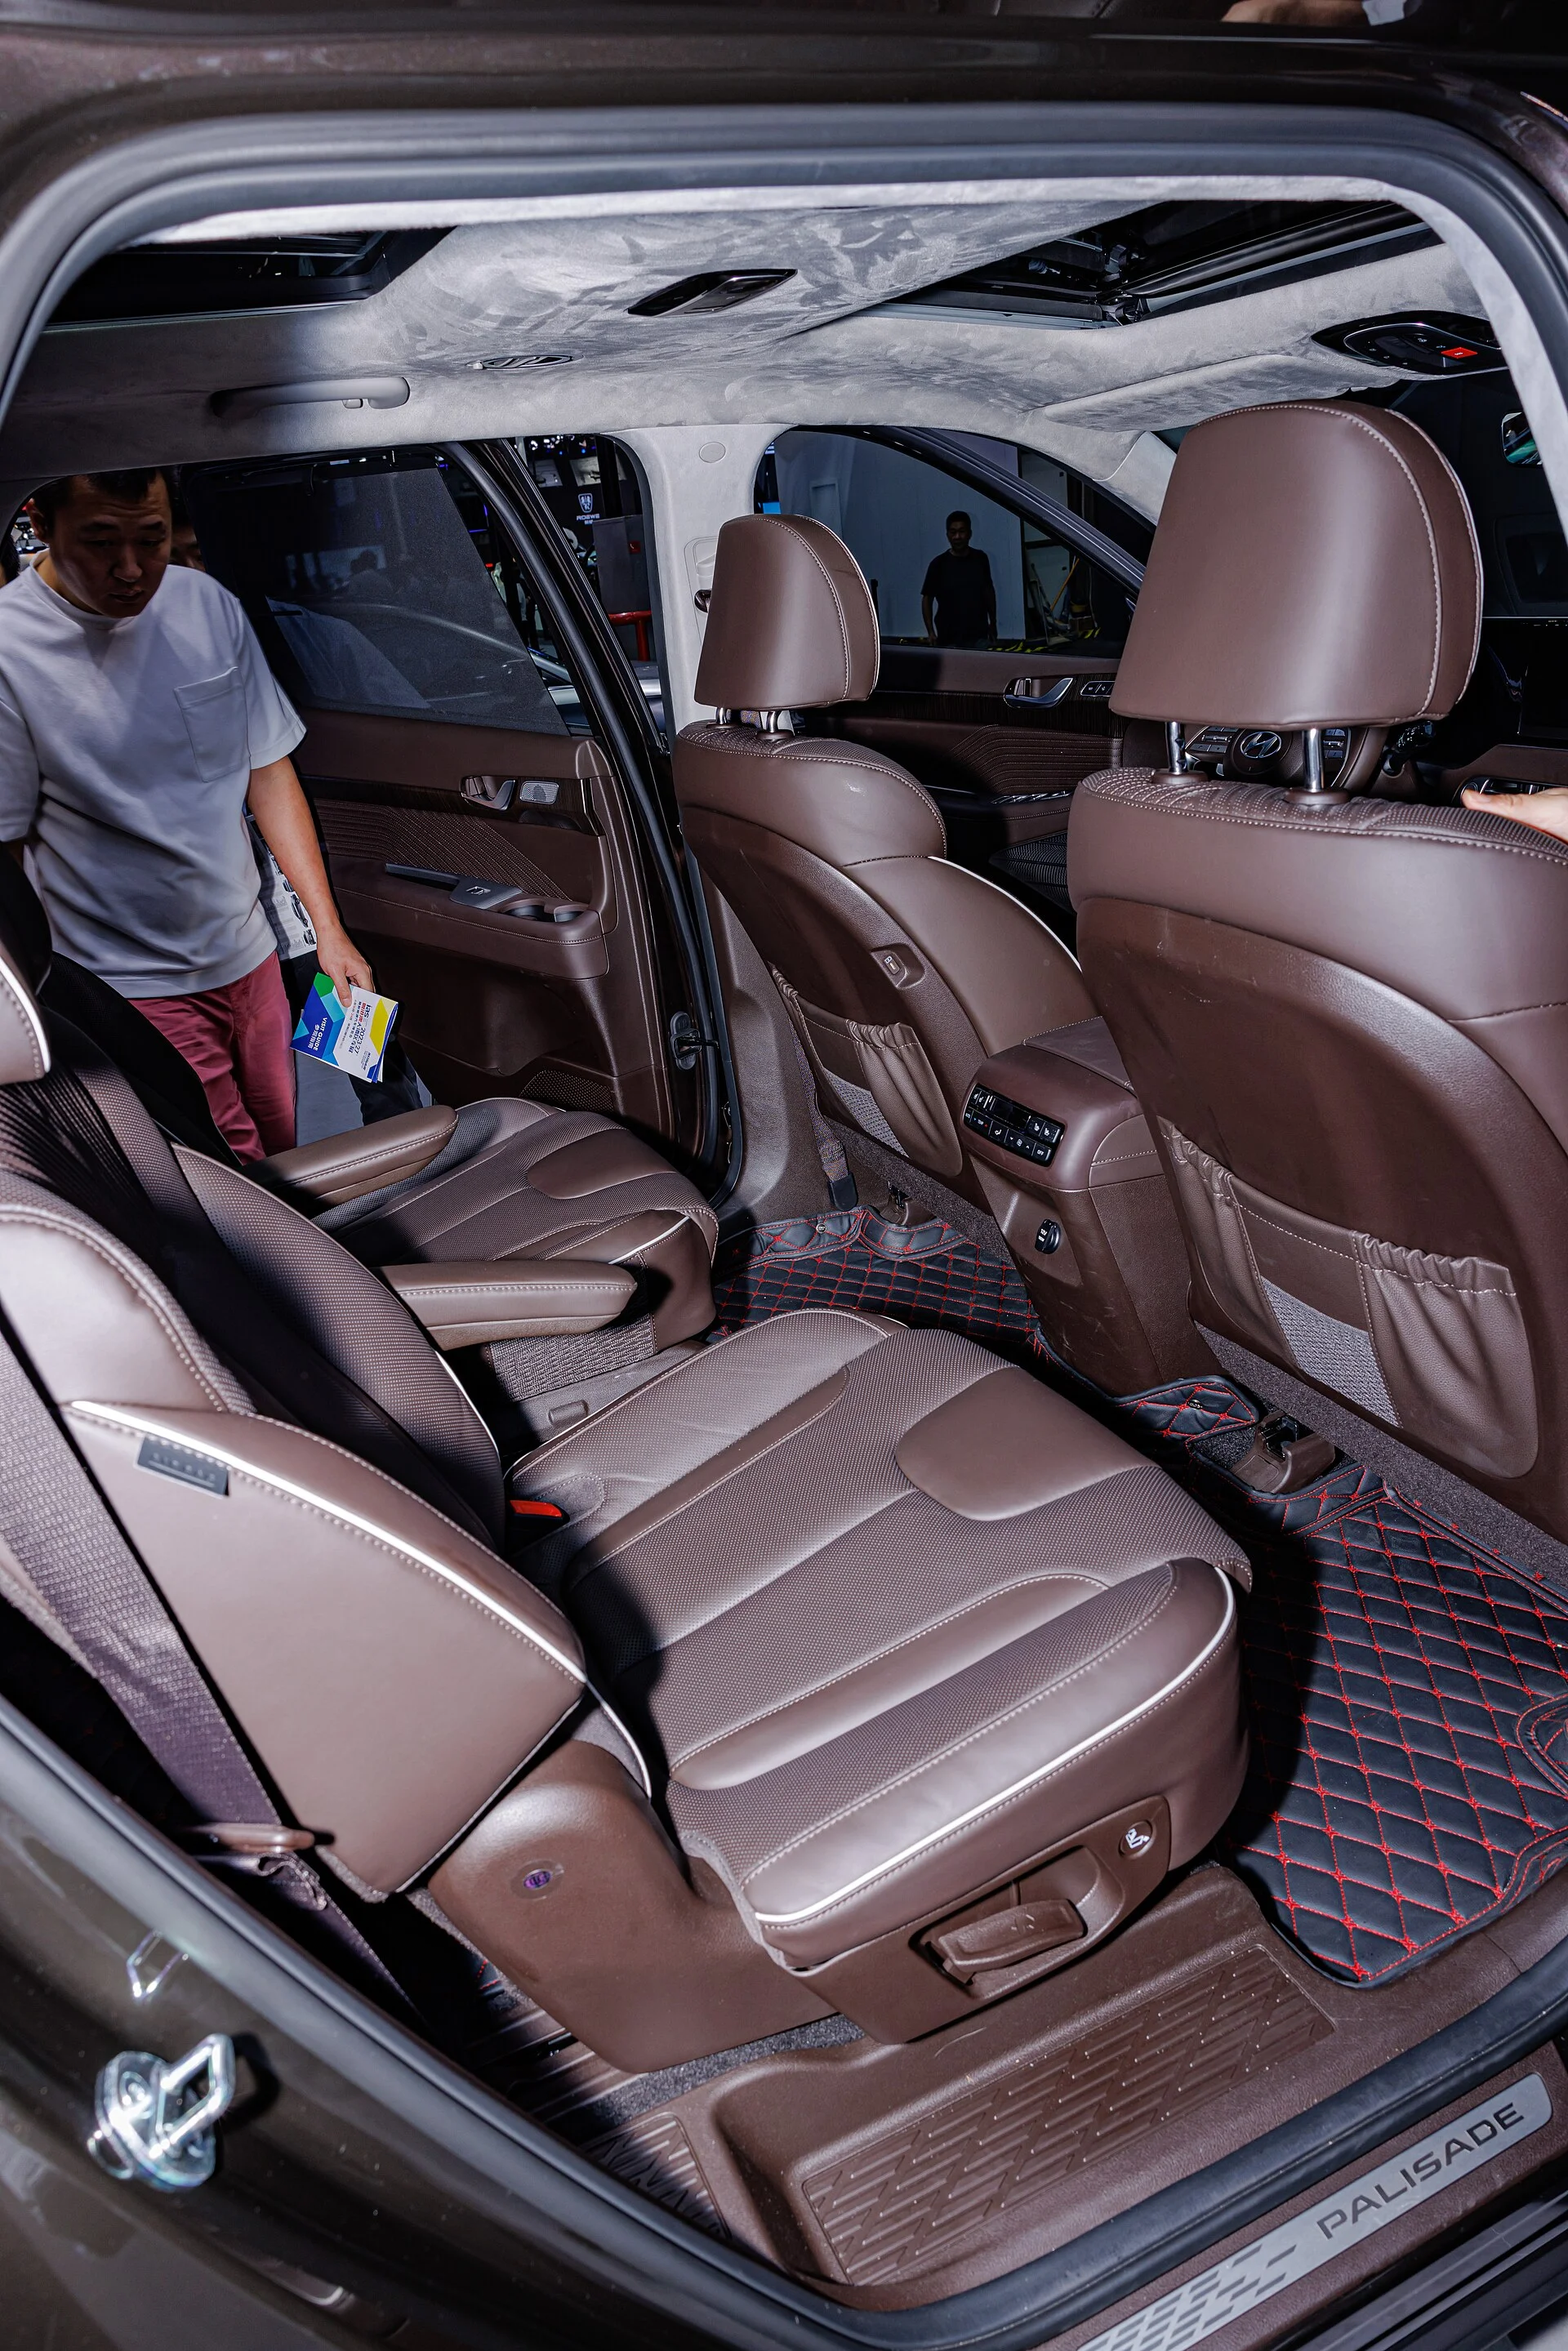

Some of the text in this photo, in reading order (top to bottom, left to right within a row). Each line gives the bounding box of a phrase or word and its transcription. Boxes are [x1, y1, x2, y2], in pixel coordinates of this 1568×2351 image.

[313, 1017, 327, 1051] VISIT GUIDE
[356, 1026, 366, 1045] 2023
[1316, 2102, 1525, 2240] PALISADE
